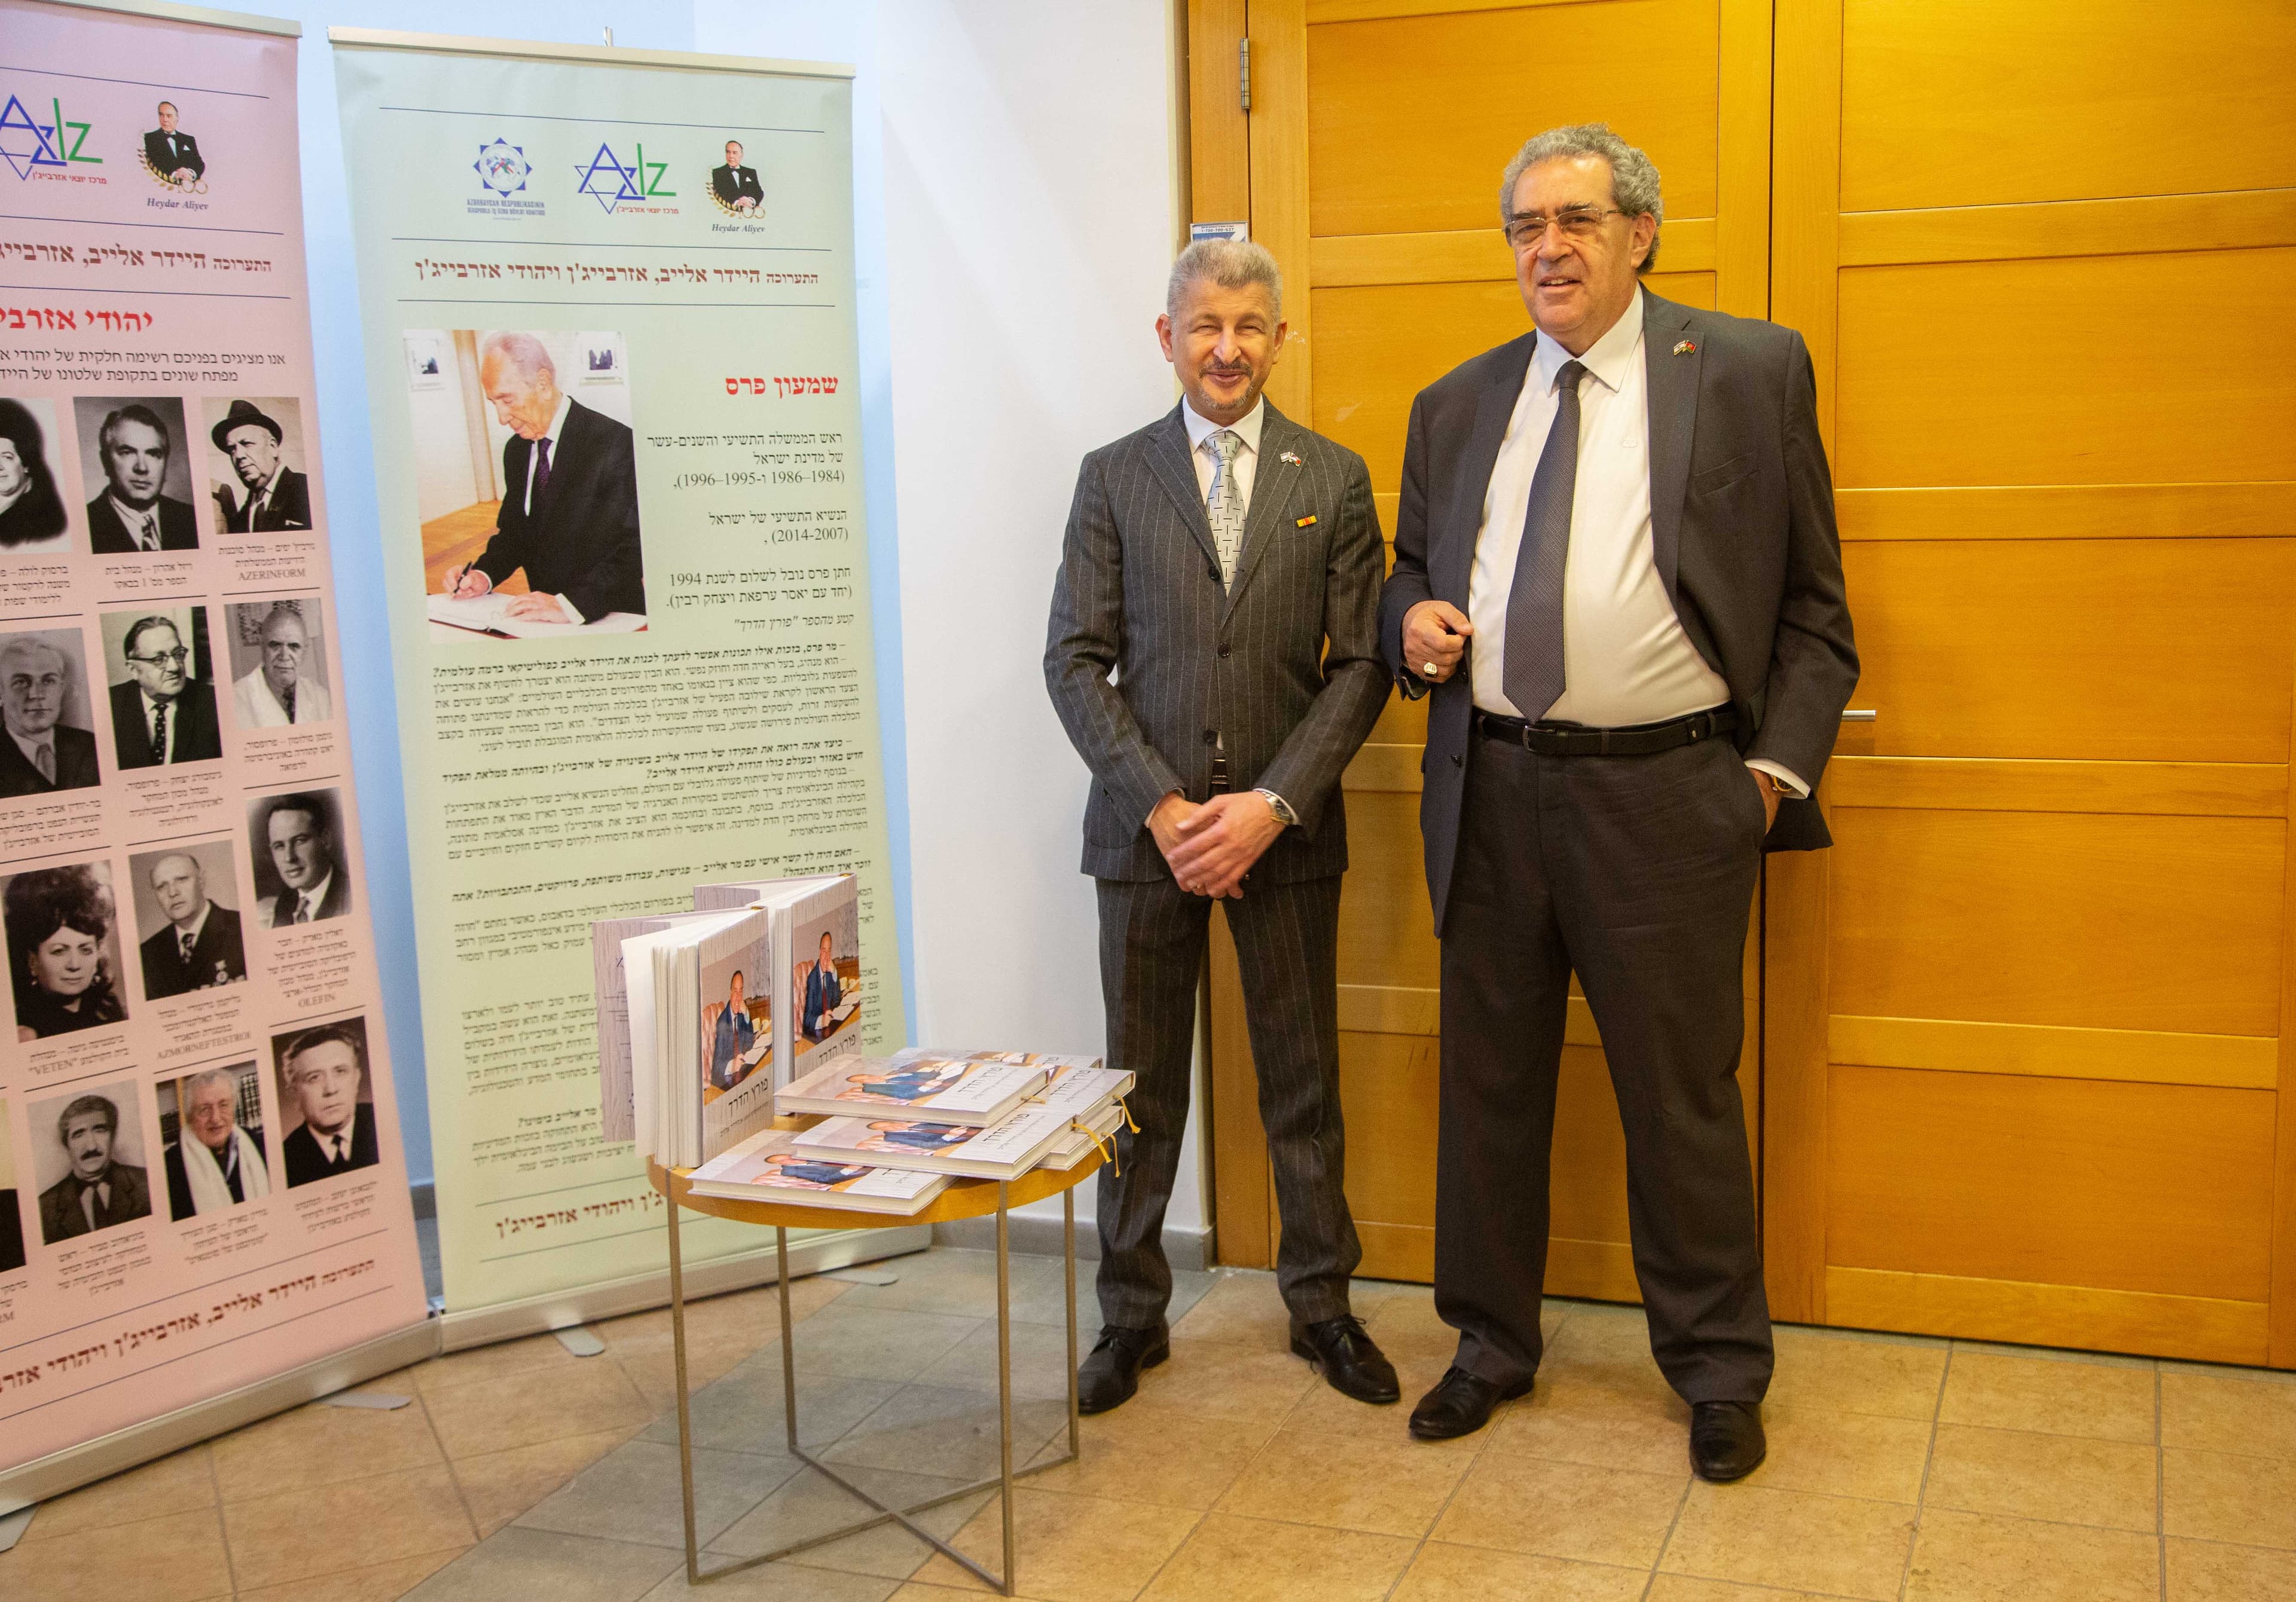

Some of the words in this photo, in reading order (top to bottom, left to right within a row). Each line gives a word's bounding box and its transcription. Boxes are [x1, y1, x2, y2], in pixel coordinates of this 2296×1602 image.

[33, 171, 67, 181] אזרבייג'ן
[147, 198, 180, 209] Heydar
[182, 201, 209, 212] Aliyev
[712, 224, 740, 233] Heydar
[741, 225, 765, 234] Aliyev
[83, 243, 144, 268] אלייב,
[151, 250, 206, 268] היידר
[213, 258, 271, 271] התערוכה
[415, 258, 501, 280] אזרבייג'ן
[507, 265, 560, 280] ויהודי
[567, 263, 648, 284] אזרבייג'ן
[655, 264, 707, 285] אלייב,
[713, 269, 760, 283] היידר
[767, 274, 818, 284] התערוכה
[85, 310, 152, 332] יהודי
[14, 350, 50, 360] יהודי
[54, 349, 74, 362] של
[79, 350, 122, 364] חלקית
[126, 353, 169, 363] רשימה
[173, 353, 218, 363] בפניכם
[221, 354, 264, 363] מציגים
[267, 354, 286, 364] אנו
[32, 366, 52, 380] של
[56, 368, 102, 380] שלטונו
[106, 371, 158, 383] בתקופת
[161, 371, 198, 381] שונים
[202, 371, 238, 381] מפתח
[726, 378, 765, 395] פרס
[774, 377, 838, 399] שמעון
[647, 436, 718, 447] והשנים-עשר
[722, 435, 764, 445] התשיעי
[769, 432, 816, 444] הממשלה
[820, 433, 842, 443] ראש
[753, 451, 789, 464] ישראל
[795, 453, 825, 463] מדינת
[828, 450, 843, 463] של
[709, 512, 745, 525] ישראל
[749, 510, 767, 523] של
[771, 512, 811, 522] התשיעי
[816, 510, 846, 521] הנשיא
[239, 569, 306, 580] AZERINFORM
[671, 573, 701, 586] 1994
[706, 570, 735, 584] לשנת
[740, 568, 776, 582] לשלום
[780, 568, 804, 580] נובל
[808, 569, 829, 579] פרס
[833, 568, 850, 580] חתן
[740, 591, 777, 602] ערפאת
[781, 589, 808, 600] יאסר
[813, 588, 826, 598] עם
[831, 585, 851, 598] (יחד
[667, 595, 699, 608] רבין).
[703, 593, 735, 606] ויצחק
[735, 619, 765, 631] הדרך"
[770, 616, 798, 630] "פורץ
[802, 616, 833, 625] מהספר
[836, 614, 854, 624] קטע
[839, 1034, 856, 1054] פורץ
[819, 1045, 837, 1065] הדרך
[751, 1078, 768, 1100] פורץ
[728, 1092, 748, 1117] הדרך
[583, 1199, 634, 1216] ויהודי
[496, 1208, 578, 1239] אזרבייג'ן
[322, 1259, 374, 1284] התערוכה
[268, 1275, 316, 1298] היידר
[207, 1292, 262, 1324] אלייב,
[114, 1313, 200, 1357] אזרבייג'ן
[47, 1344, 106, 1371] ויהודי
